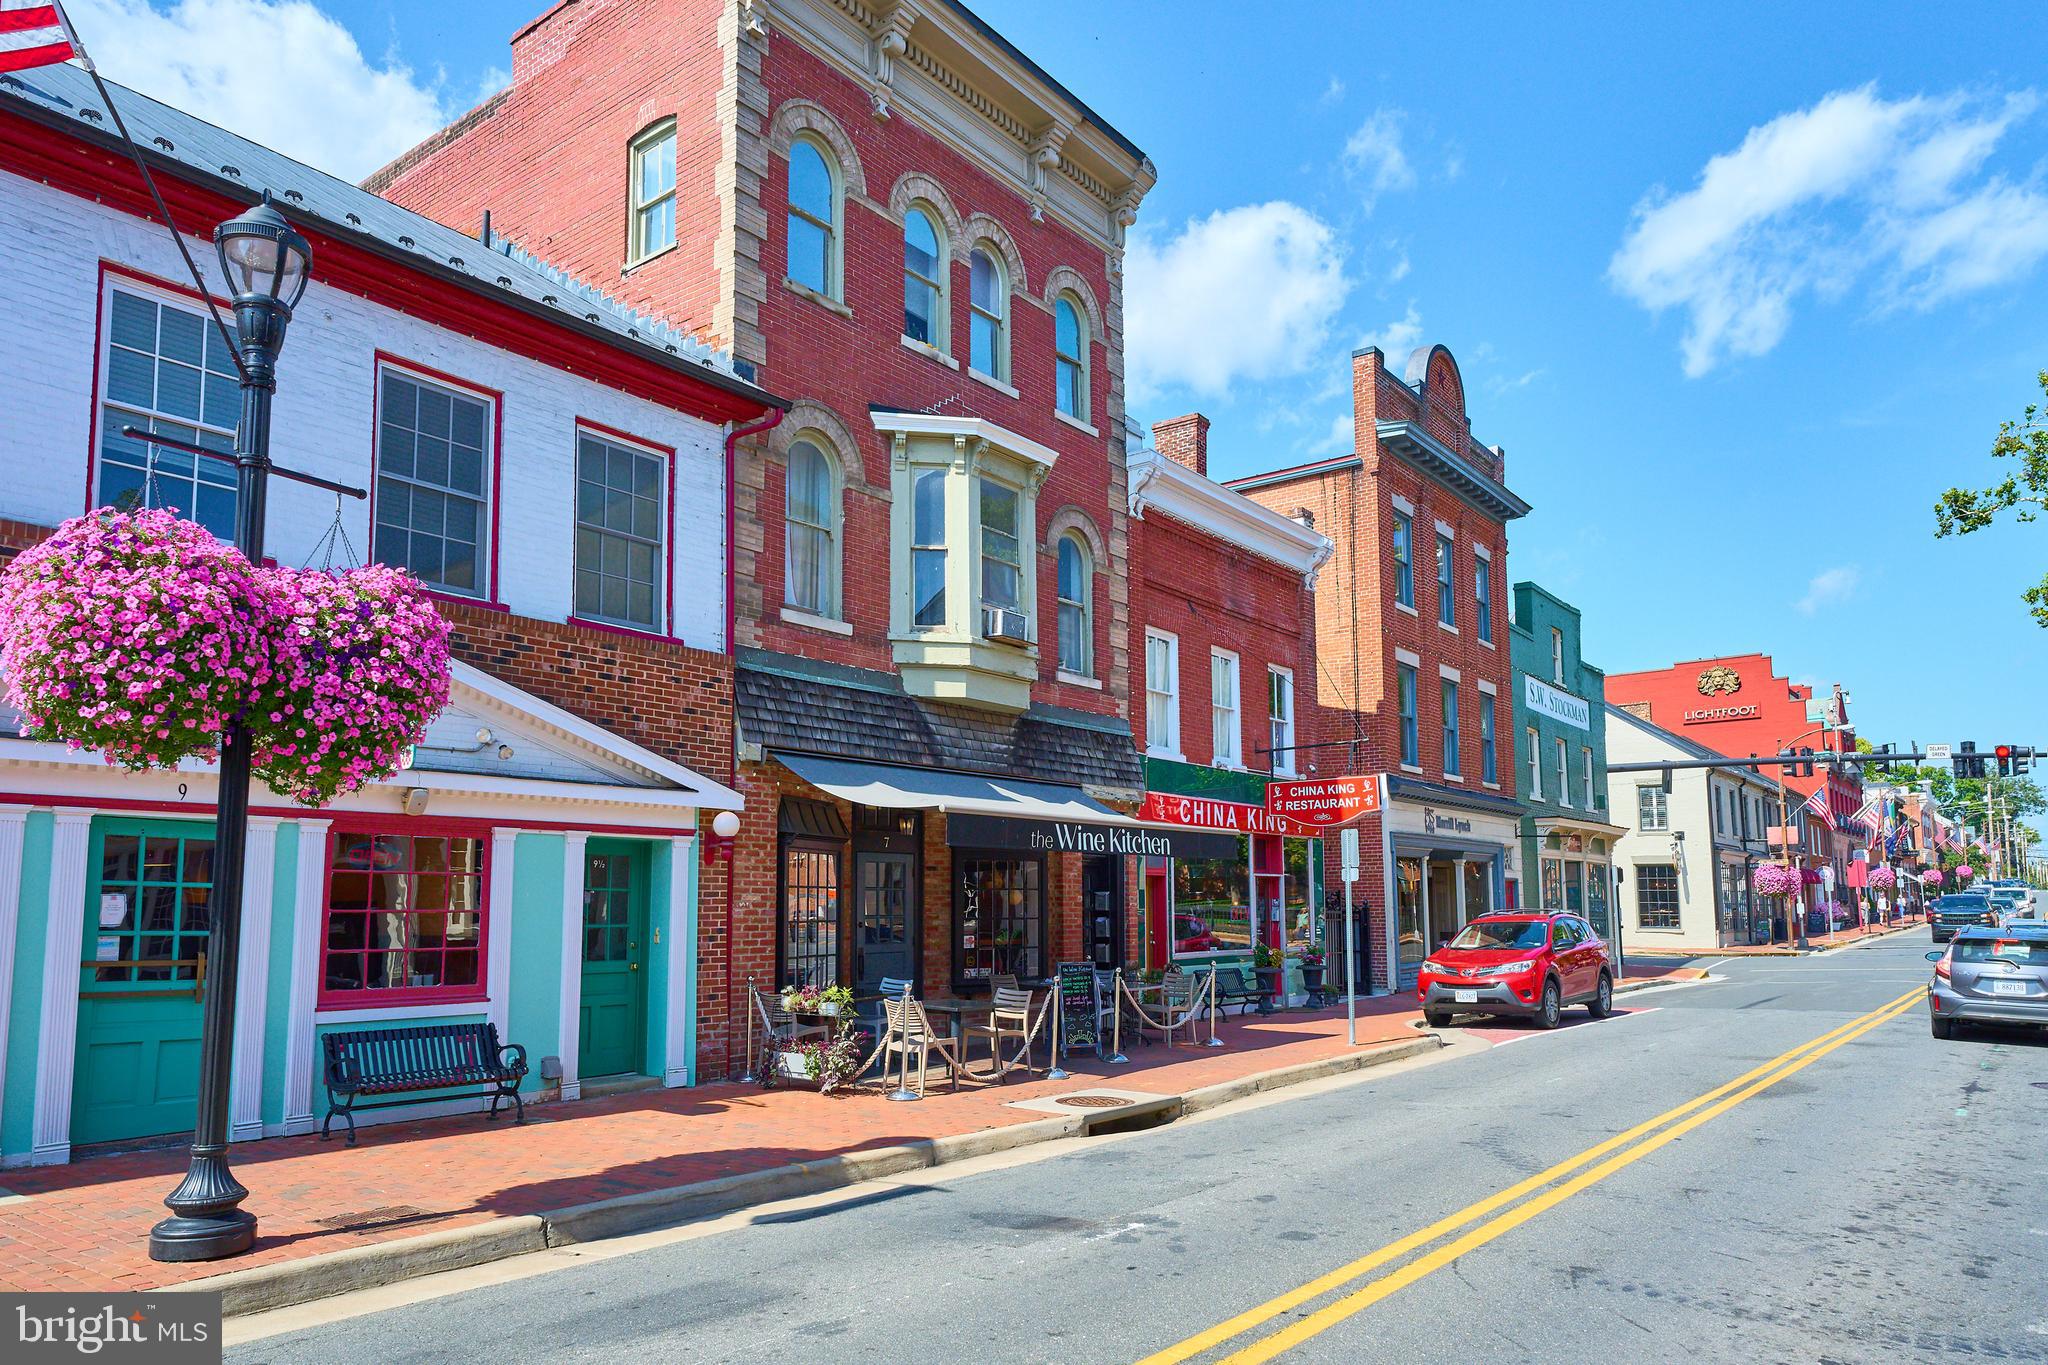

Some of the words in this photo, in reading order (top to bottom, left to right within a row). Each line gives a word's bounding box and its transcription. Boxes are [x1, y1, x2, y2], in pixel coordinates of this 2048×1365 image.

[1549, 691, 1587, 724] STOCKMAN
[1684, 705, 1758, 720] LIGHTFOOT
[178, 783, 188, 801] 9
[1290, 785, 1325, 797] CHINA
[1327, 783, 1355, 795] KING
[1285, 797, 1361, 811] RESTAURANT
[1179, 799, 1238, 829] CHINA
[1247, 807, 1287, 833] KING
[883, 836, 890, 848] 7
[1031, 829, 1054, 849] the
[1055, 823, 1105, 852] Wine
[1109, 827, 1171, 855] Kitchen
